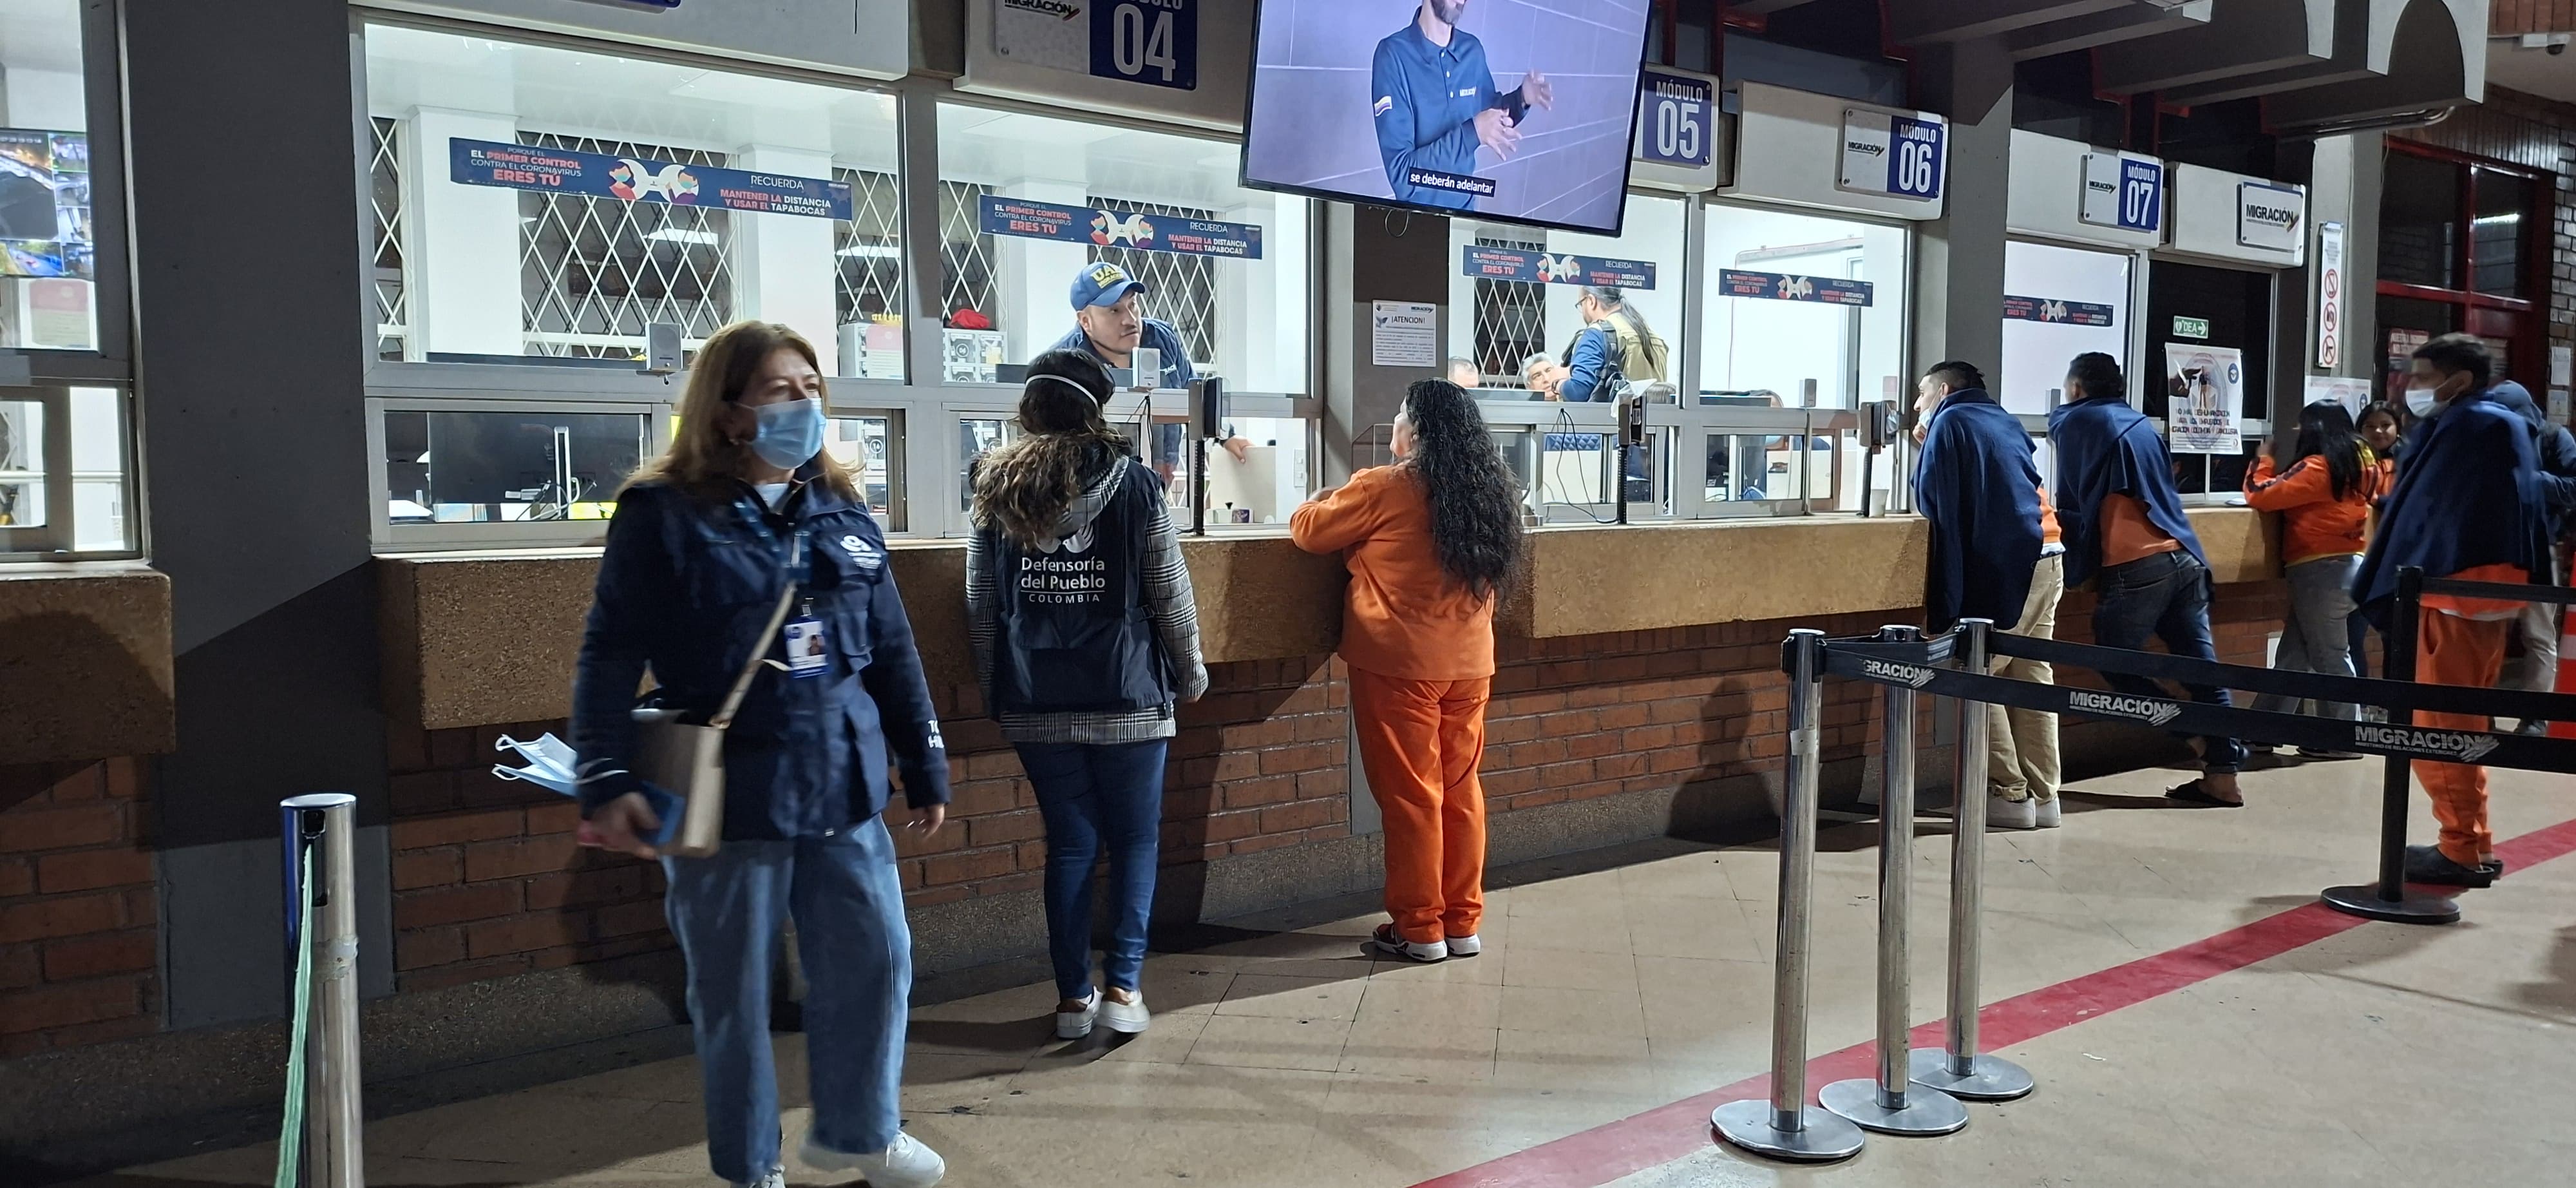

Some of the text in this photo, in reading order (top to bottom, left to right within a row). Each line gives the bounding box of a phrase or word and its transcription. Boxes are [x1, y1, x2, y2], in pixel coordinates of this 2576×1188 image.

[1113, 3, 1176, 81] 04
[1656, 79, 1703, 102] MÓDULO
[1657, 100, 1700, 159] 05
[1900, 122, 1937, 143] MÓDULO
[471, 149, 582, 169] EL PRIMER CONTROL
[471, 158, 507, 169] CONTRA
[520, 164, 582, 177] CORONAVIRUS
[1899, 140, 1933, 193] 06
[493, 169, 535, 184] ERES
[2127, 164, 2155, 182] MÓDULO
[751, 175, 804, 190] RECUERDA
[1410, 173, 1493, 193] se deberán adelantar
[720, 189, 831, 208] MANTENER LA DISTANCIA
[724, 198, 826, 216] Y USAR EL TAPABOCAS
[2126, 180, 2154, 226] 07
[994, 211, 1019, 220] CONTRA
[1005, 206, 1034, 215] PRIMER
[1036, 209, 1072, 220] CONTROL
[2246, 204, 2294, 223] MIGRACIÓN
[1010, 220, 1039, 232] ERES
[1190, 222, 1229, 233] RECUERDA
[1204, 245, 1244, 254] TAPABOCAS
[1213, 238, 1247, 248] DISTANCIA
[1482, 265, 1502, 274] ERES
[2183, 321, 2197, 332] DEA
[1021, 555, 1105, 572] Defensoría
[1021, 573, 1106, 589] del Pueblo
[1028, 593, 1100, 604] COLOMBIA
[2069, 691, 2168, 716] MIGRACIÓN
[2355, 725, 2485, 751] MIGRACIÓN
